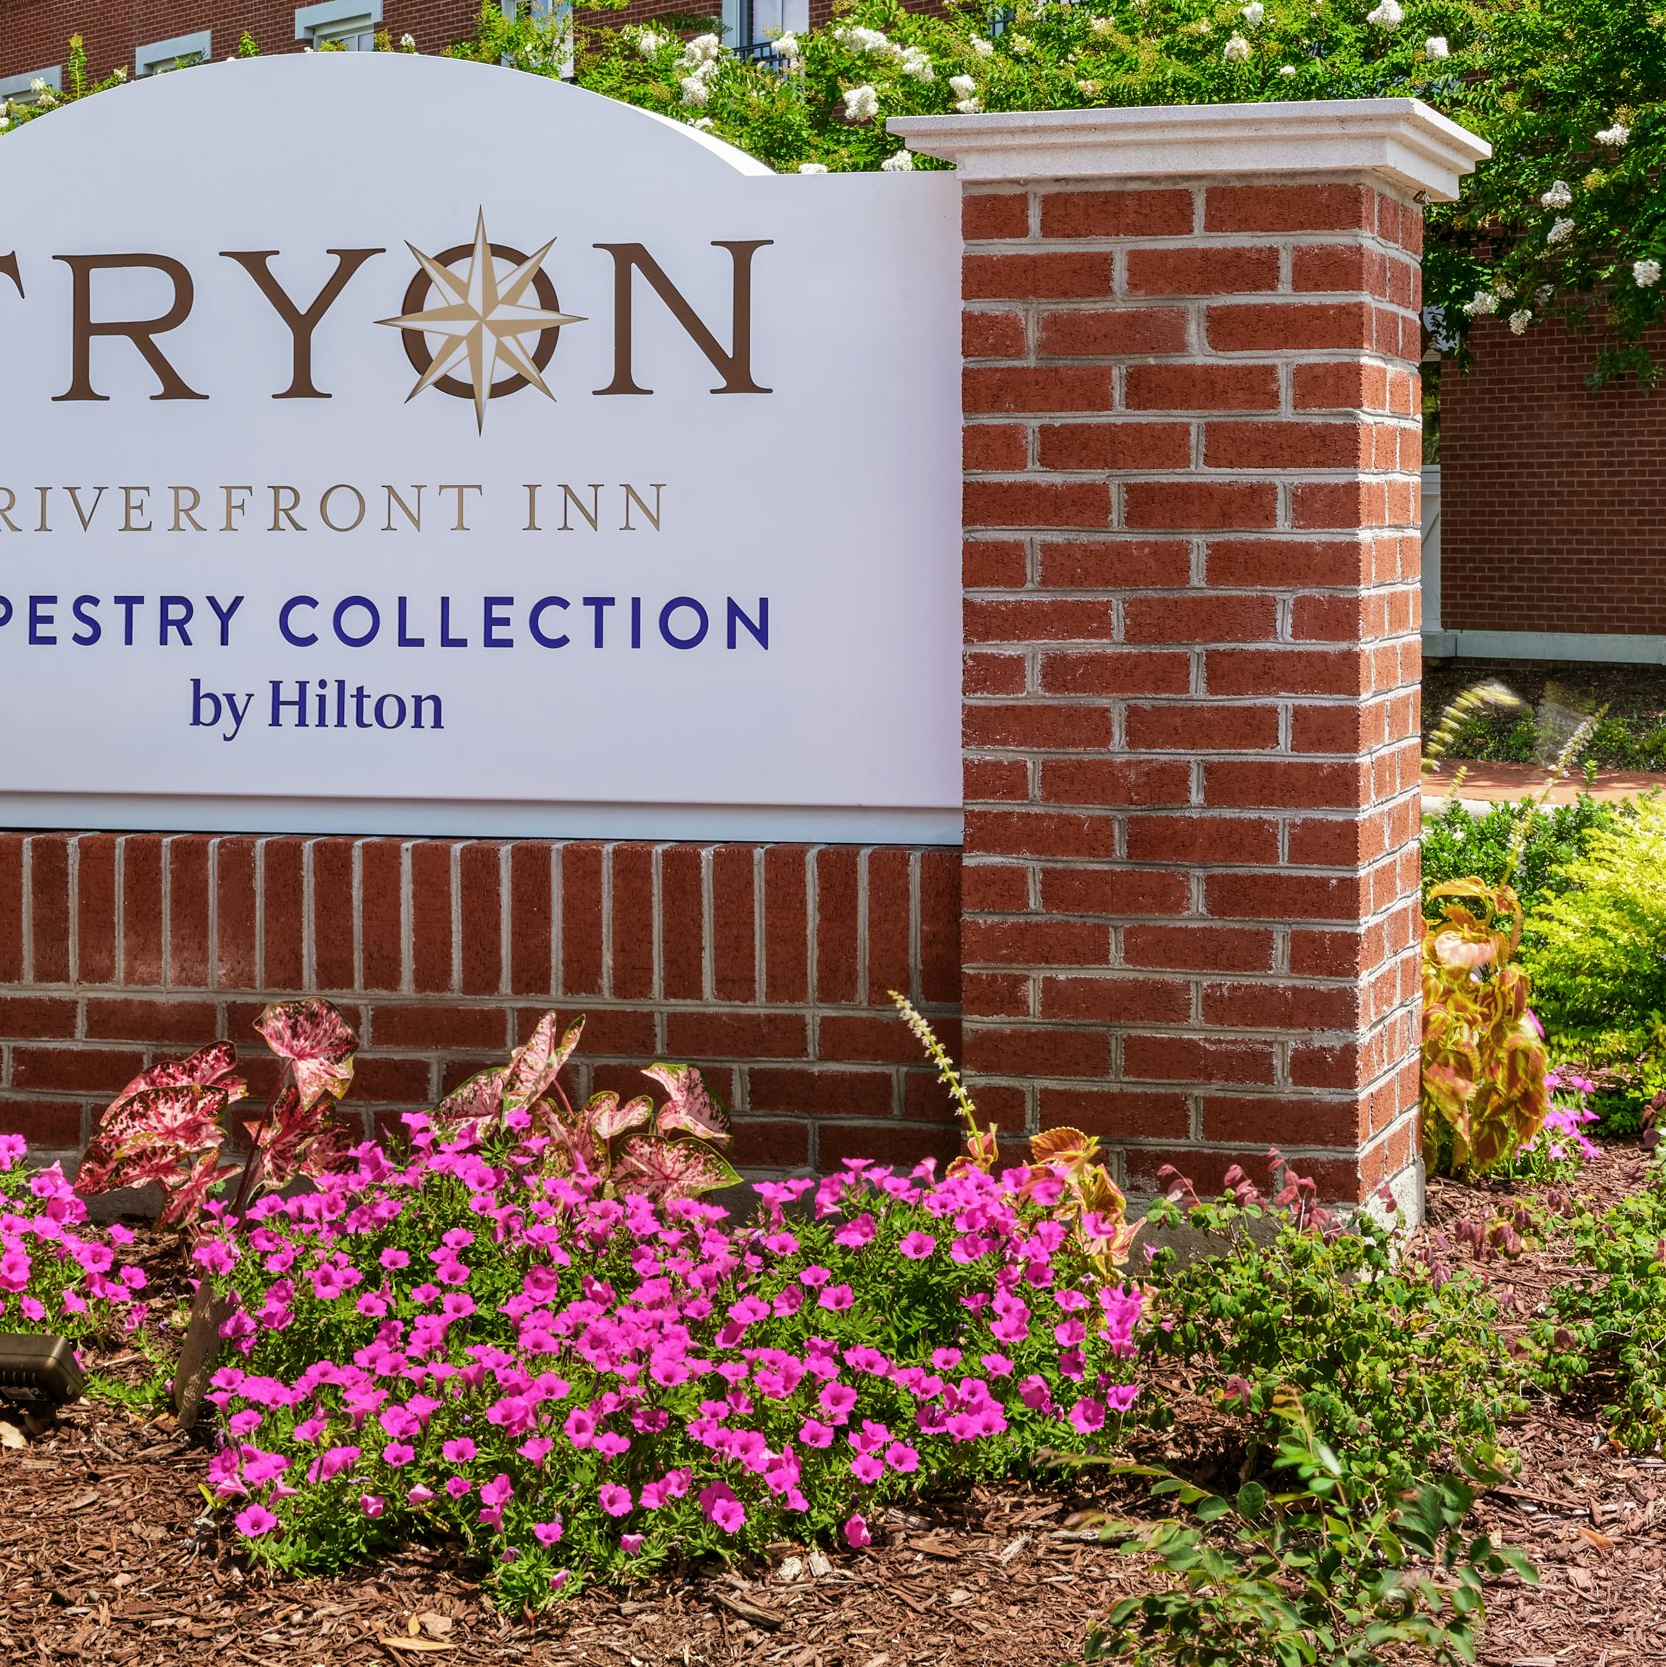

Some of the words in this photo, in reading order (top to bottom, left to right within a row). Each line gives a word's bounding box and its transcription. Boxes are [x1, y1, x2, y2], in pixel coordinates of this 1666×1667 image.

[521, 483, 667, 533] INN
[278, 594, 769, 651] COLLECTION
[188, 677, 255, 742] by
[267, 678, 445, 730] Hilton
